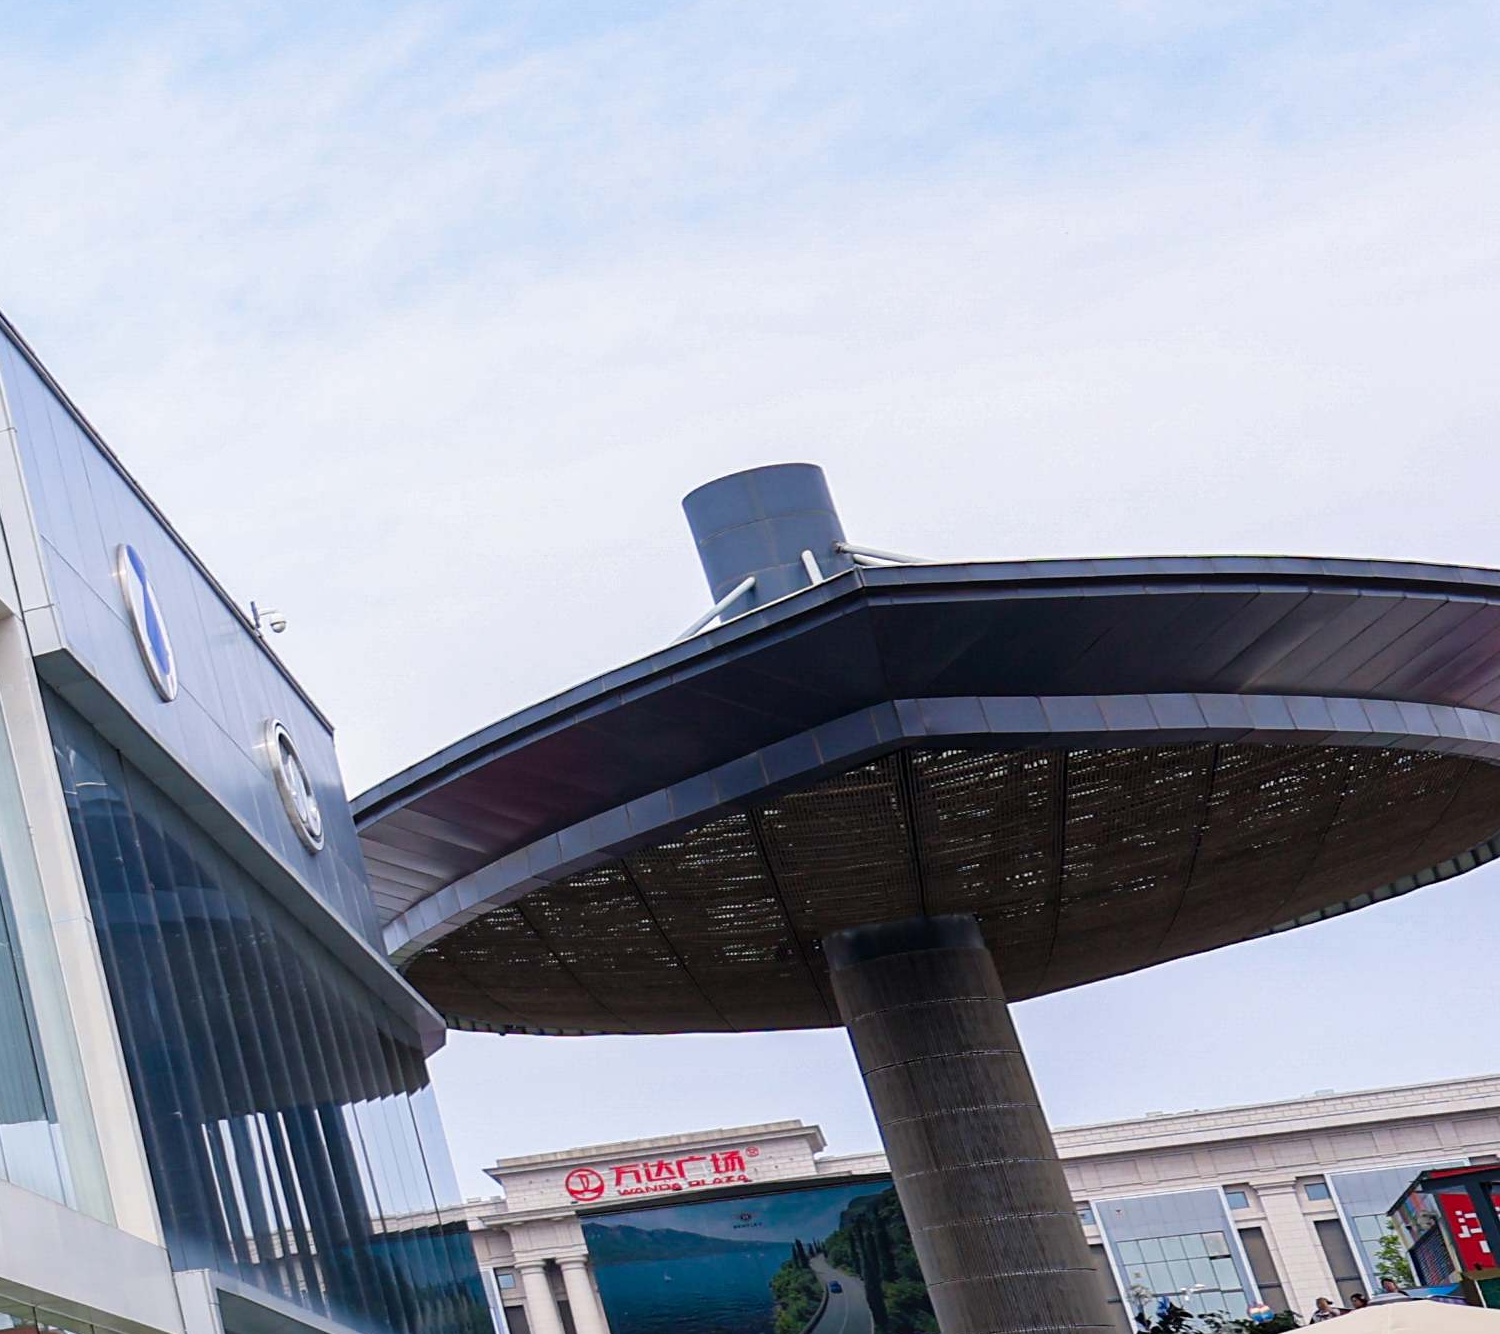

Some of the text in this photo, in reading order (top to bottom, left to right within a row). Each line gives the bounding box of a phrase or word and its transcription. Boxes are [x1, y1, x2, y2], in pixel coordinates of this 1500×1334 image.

[610, 1150, 747, 1187] 万达广场
[617, 1174, 753, 1196] WANDA PLAZA
